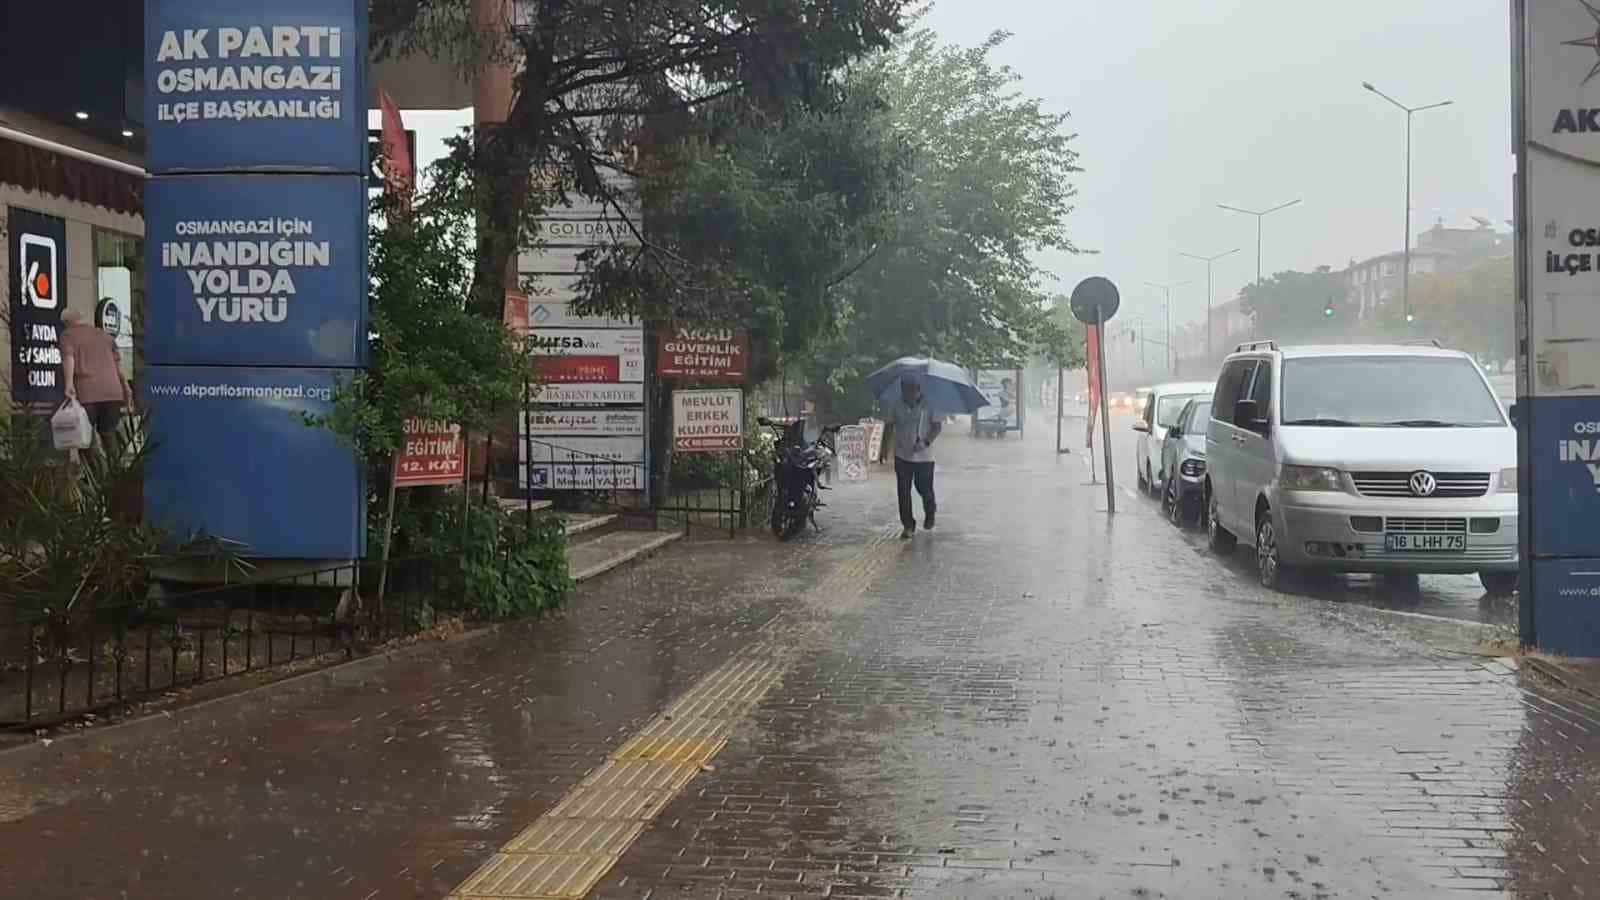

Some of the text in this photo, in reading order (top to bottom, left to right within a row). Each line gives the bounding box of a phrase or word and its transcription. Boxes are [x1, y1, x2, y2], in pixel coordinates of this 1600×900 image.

[157, 28, 209, 61] AK
[203, 96, 340, 121] BAŞKANLIĞI
[175, 216, 312, 237] OSMANGAZİ İÇİN
[1546, 250, 1592, 276] İLÇE
[187, 269, 296, 294] YOLDA
[32, 324, 57, 341] AYDA
[33, 344, 62, 364] SAHİB
[664, 342, 741, 355] GÜVENLİK
[674, 353, 731, 368] EĞİTİMİ
[28, 370, 56, 387] OLUN
[687, 410, 729, 421] ERKEK
[402, 416, 454, 433] GÜVENL
[401, 460, 460, 472] 12. KAT
[1394, 535, 1463, 548] 16 LHH 75
